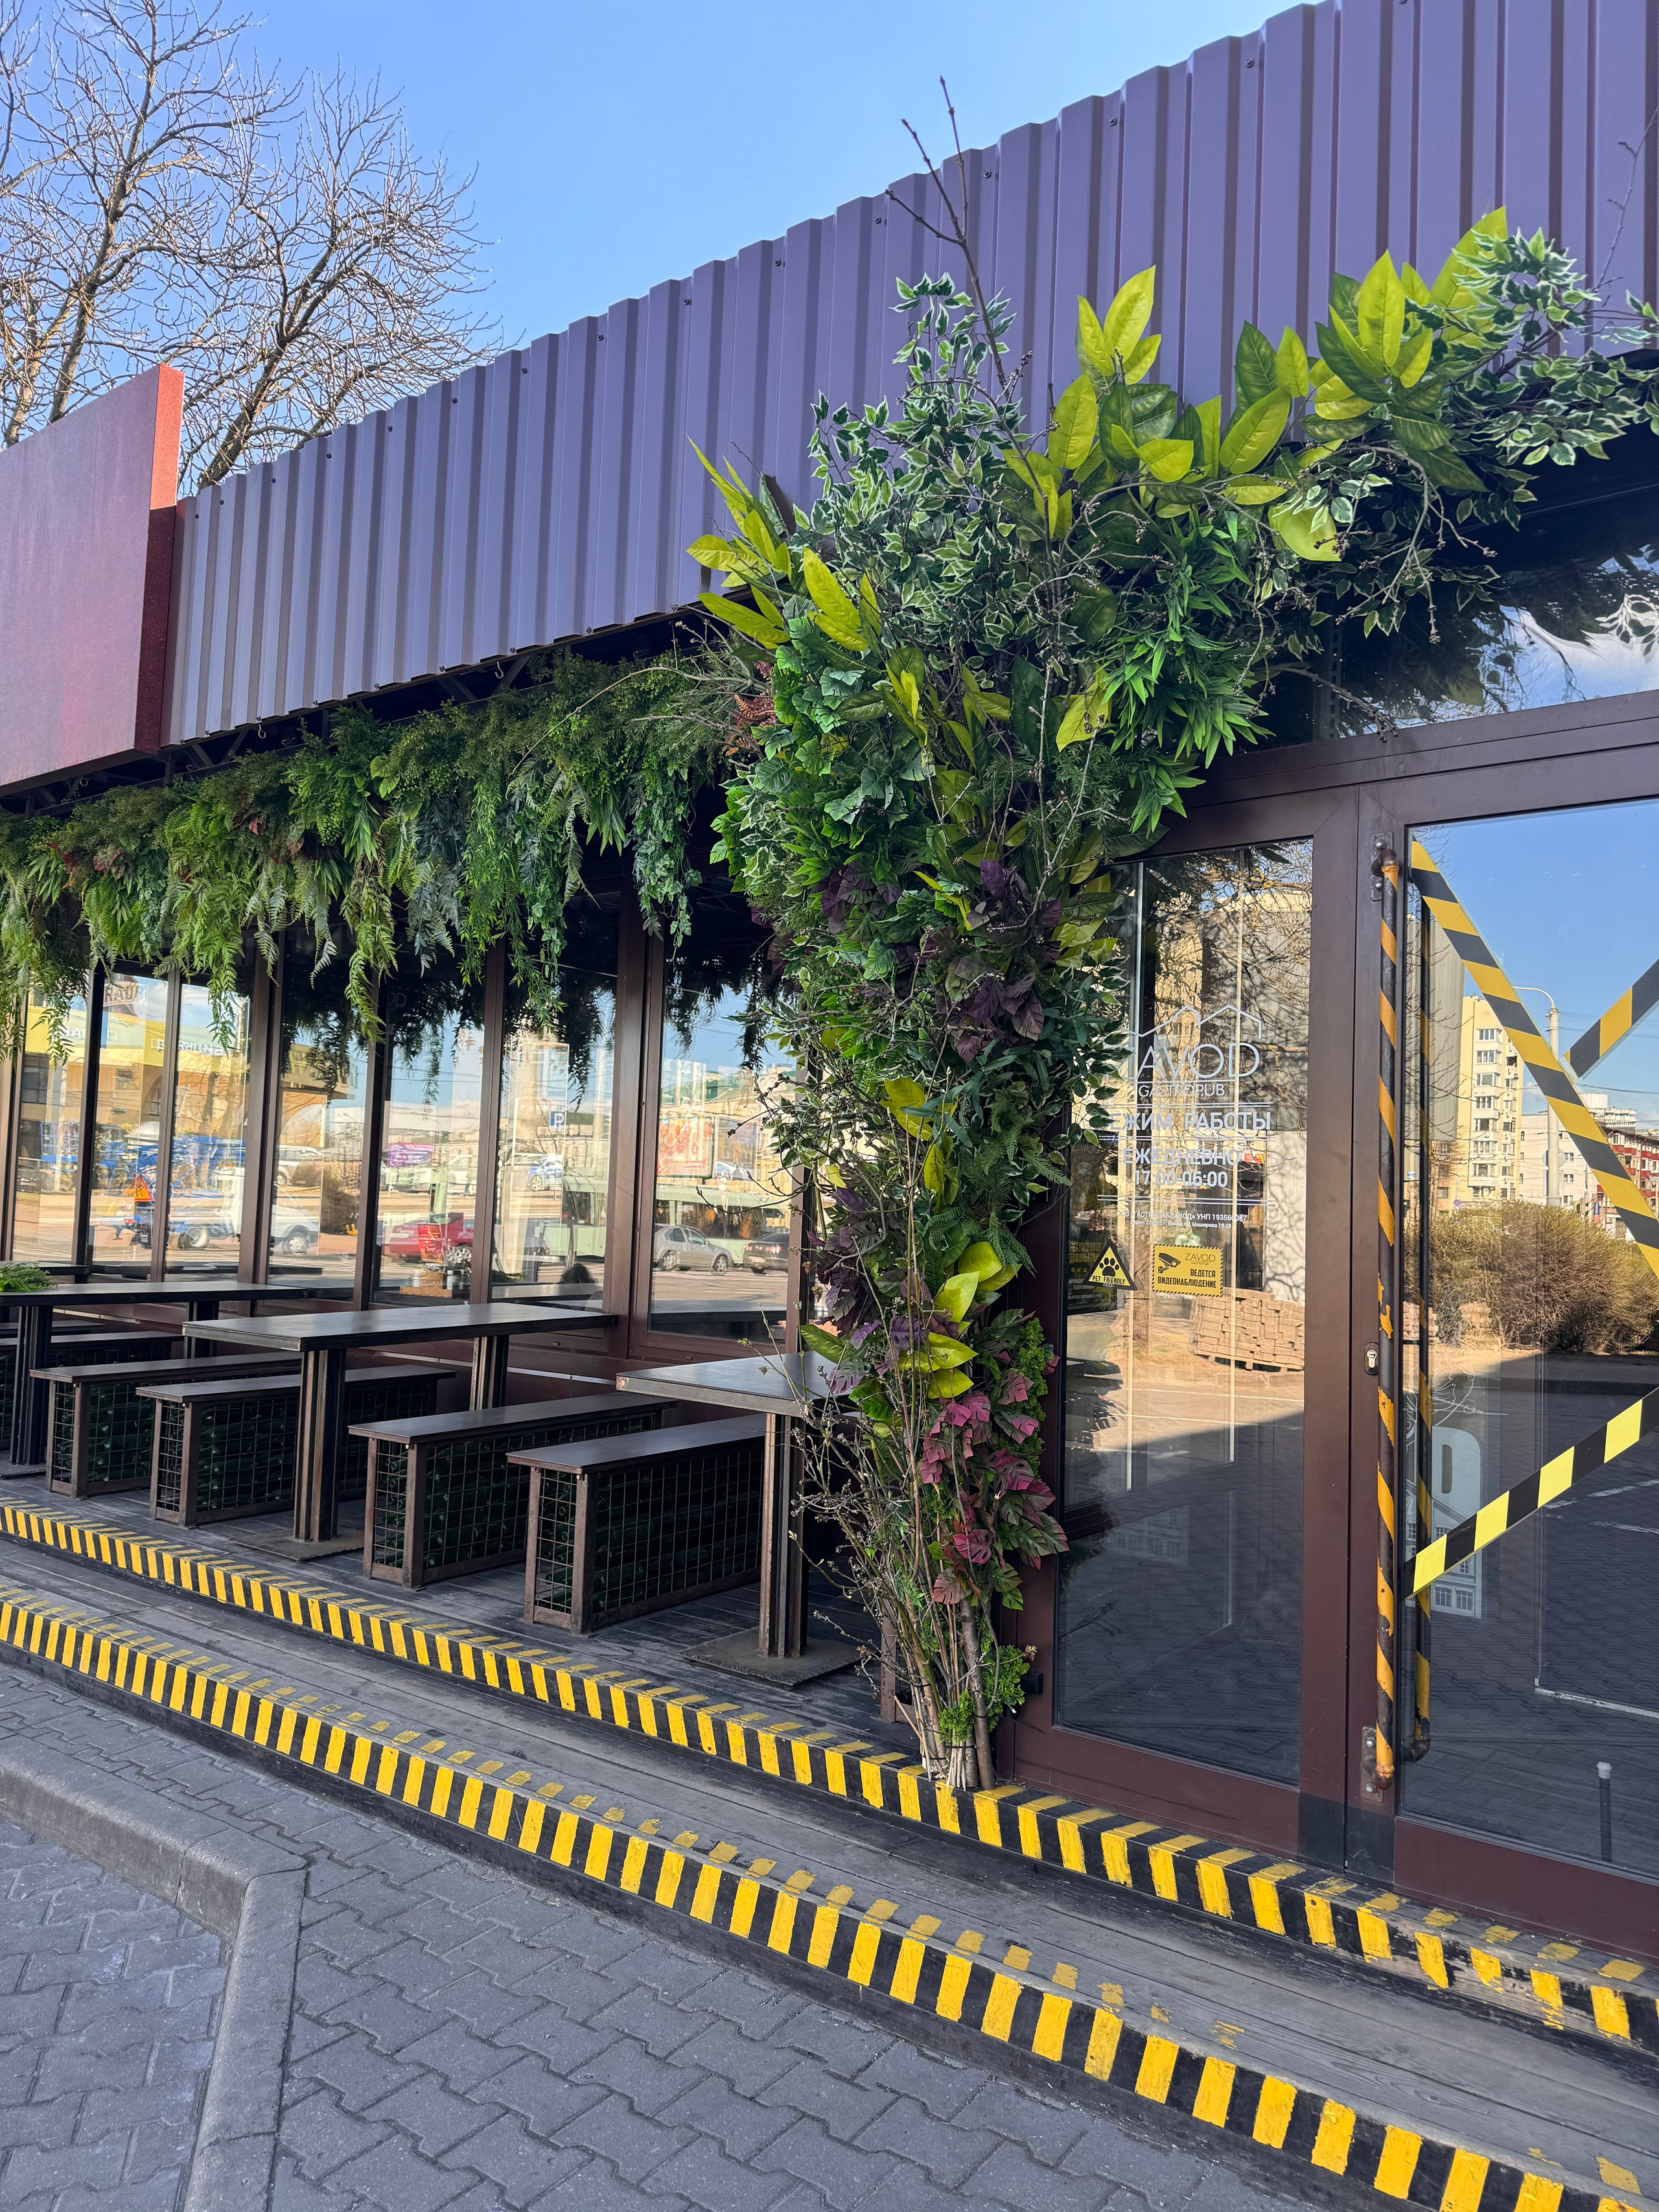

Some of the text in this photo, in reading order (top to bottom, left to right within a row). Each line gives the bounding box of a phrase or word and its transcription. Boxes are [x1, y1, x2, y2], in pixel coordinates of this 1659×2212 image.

[1138, 1084, 1225, 1097] GASTROPUB
[1109, 1112, 1271, 1130] ЕЖИМ РАБОТЫ
[1123, 1148, 1240, 1167] ЕЖЕДНЕВНО
[1135, 1170, 1228, 1187] 17:00-06:00
[1185, 1252, 1216, 1263] ZAVOD
[1190, 1268, 1216, 1278] ВЕДЕТСЯ
[1103, 1276, 1126, 1285] FRIENDLY
[1157, 1276, 1216, 1288] ВИДЕОНАБЛЮДЕНИЕ
